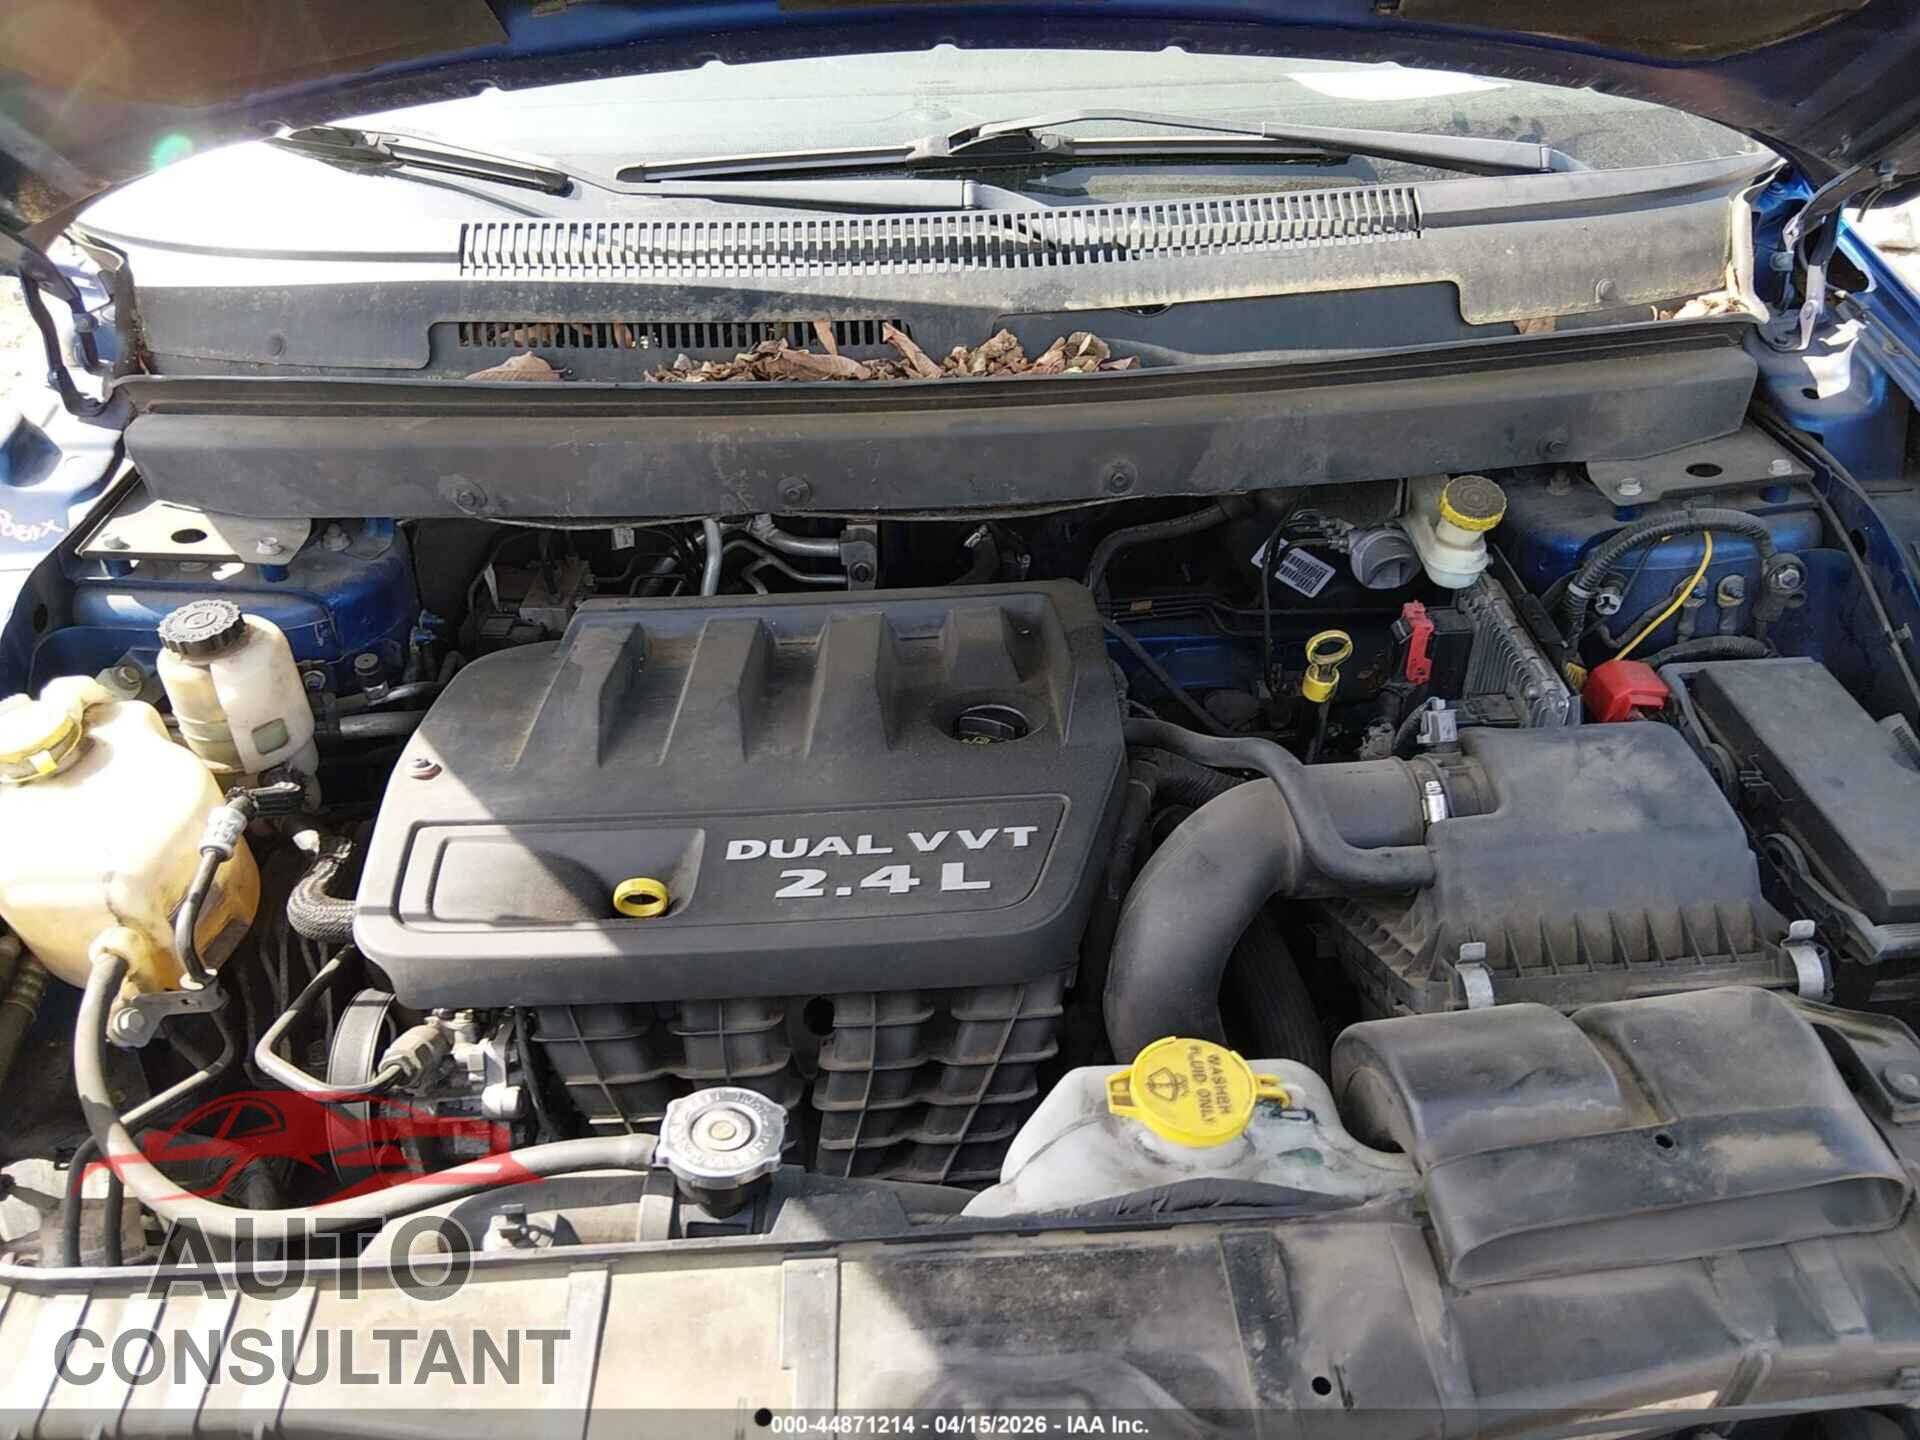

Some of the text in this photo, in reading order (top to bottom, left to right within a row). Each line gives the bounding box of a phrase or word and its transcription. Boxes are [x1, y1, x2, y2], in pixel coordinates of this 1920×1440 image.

[725, 826, 1038, 861] DUAL VVT
[775, 862, 991, 899] 2.4 L
[1207, 1053, 1232, 1115] WASHER
[1196, 1087, 1217, 1125] ONLY
